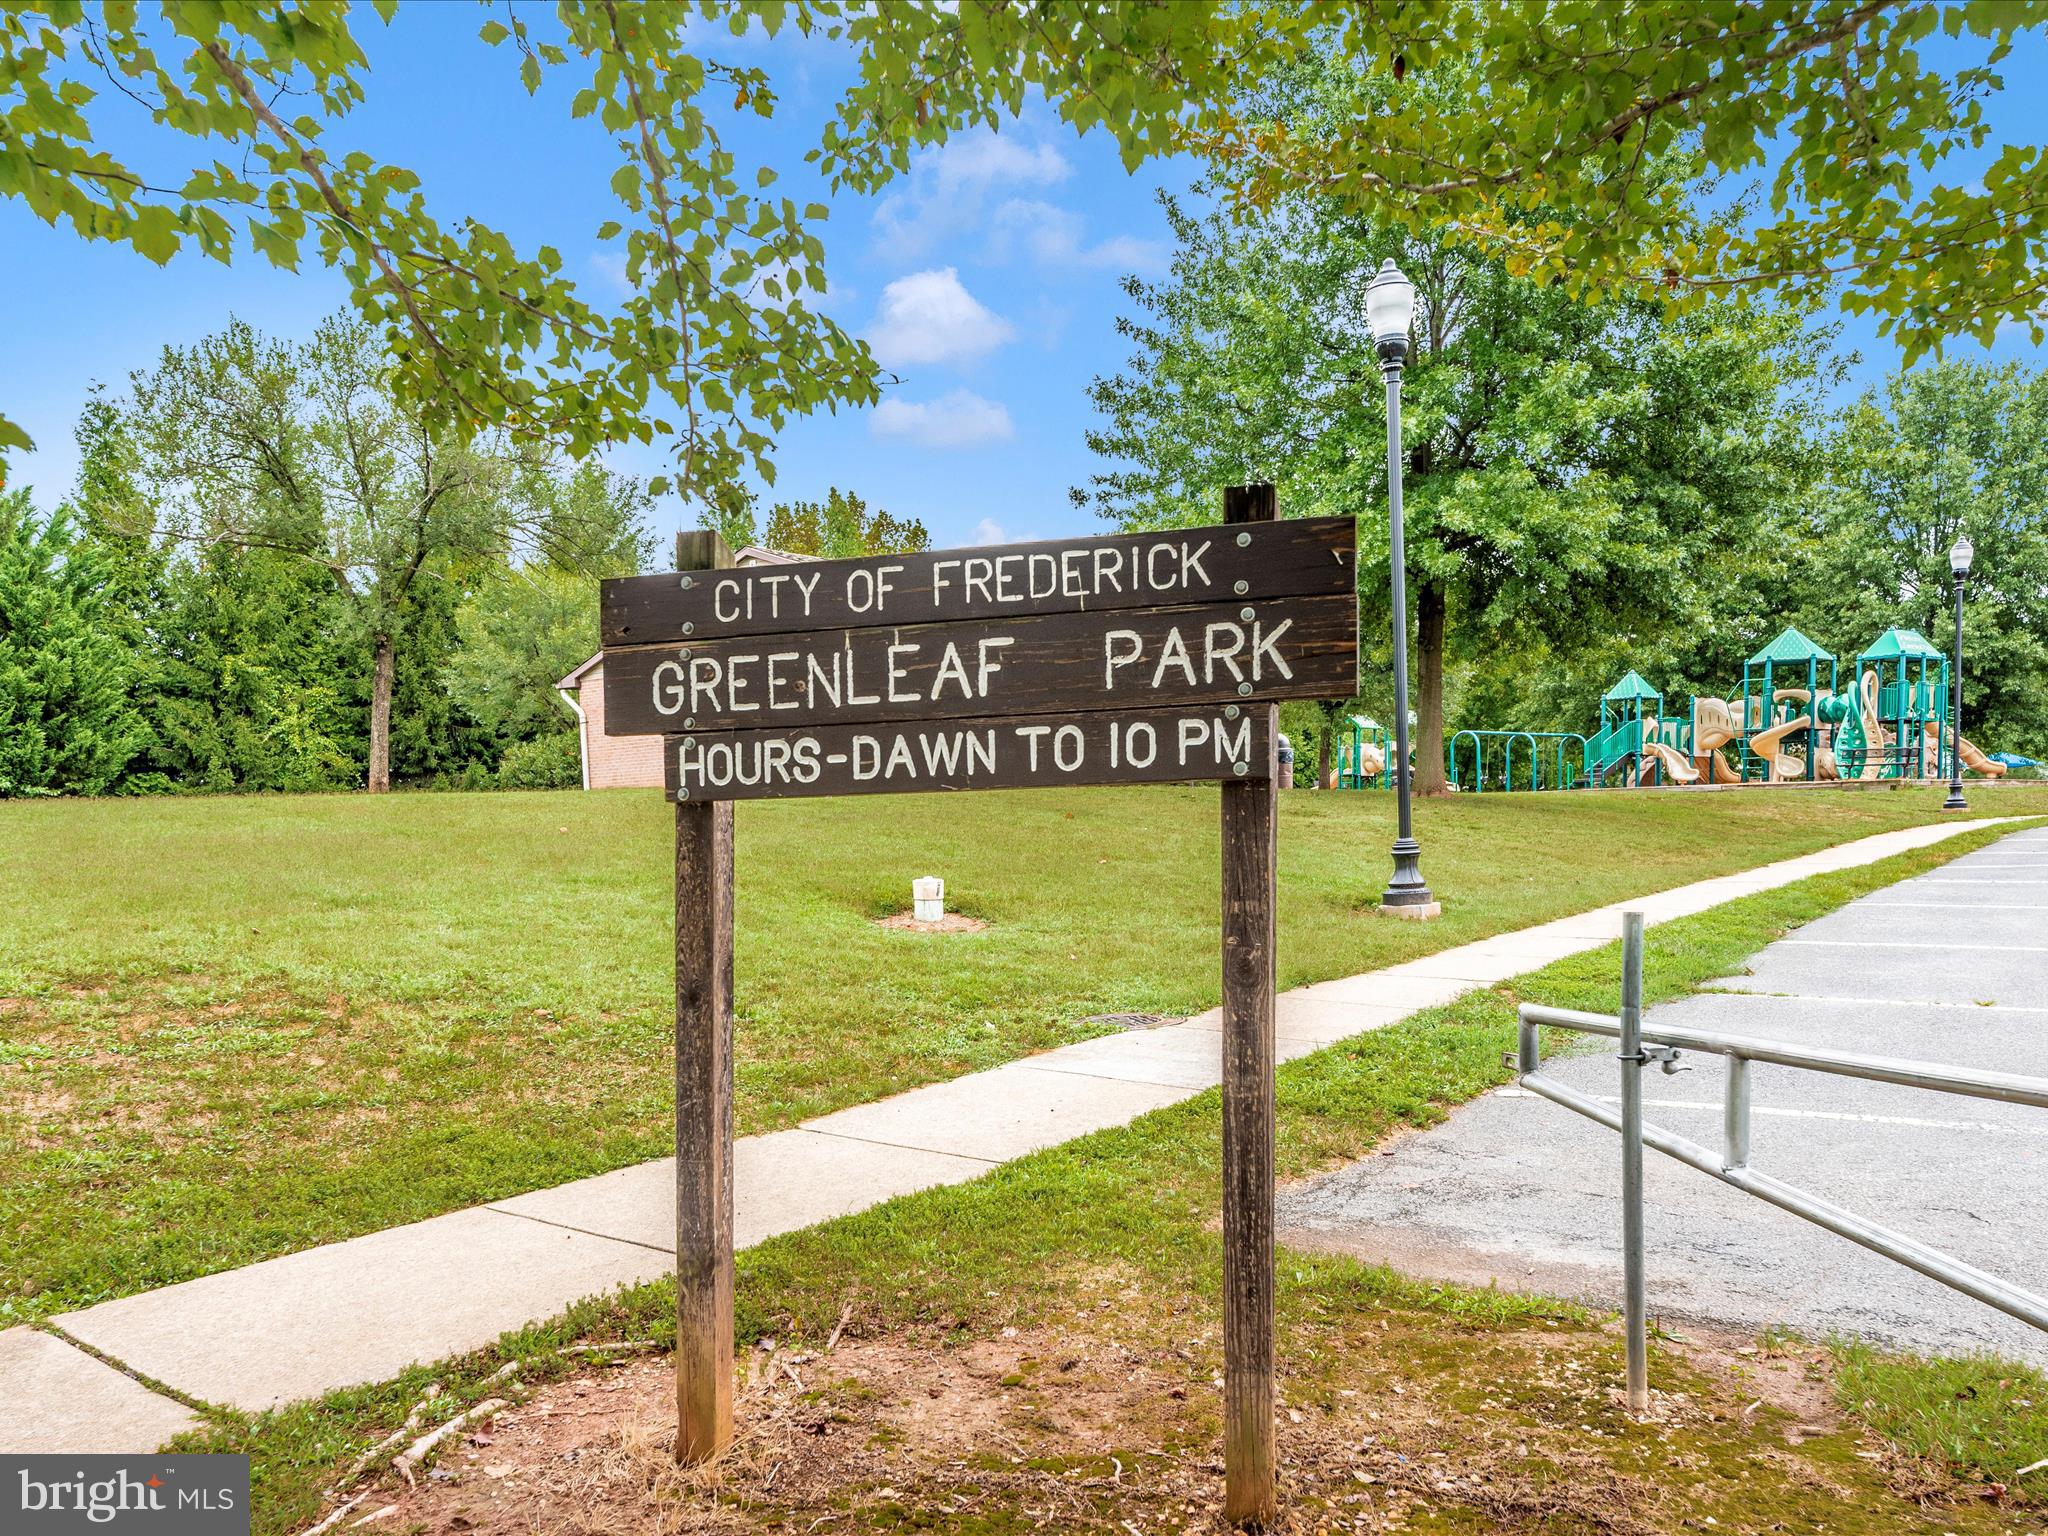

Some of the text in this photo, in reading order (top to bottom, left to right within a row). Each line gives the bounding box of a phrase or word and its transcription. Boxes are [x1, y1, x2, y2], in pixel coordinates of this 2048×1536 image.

[714, 541, 1212, 623] CITY OF FREDERICK
[652, 618, 1293, 715] GREENLEAF PARK
[1015, 724, 1085, 772] TO
[1110, 722, 1157, 768] 10
[1178, 717, 1251, 765] PM
